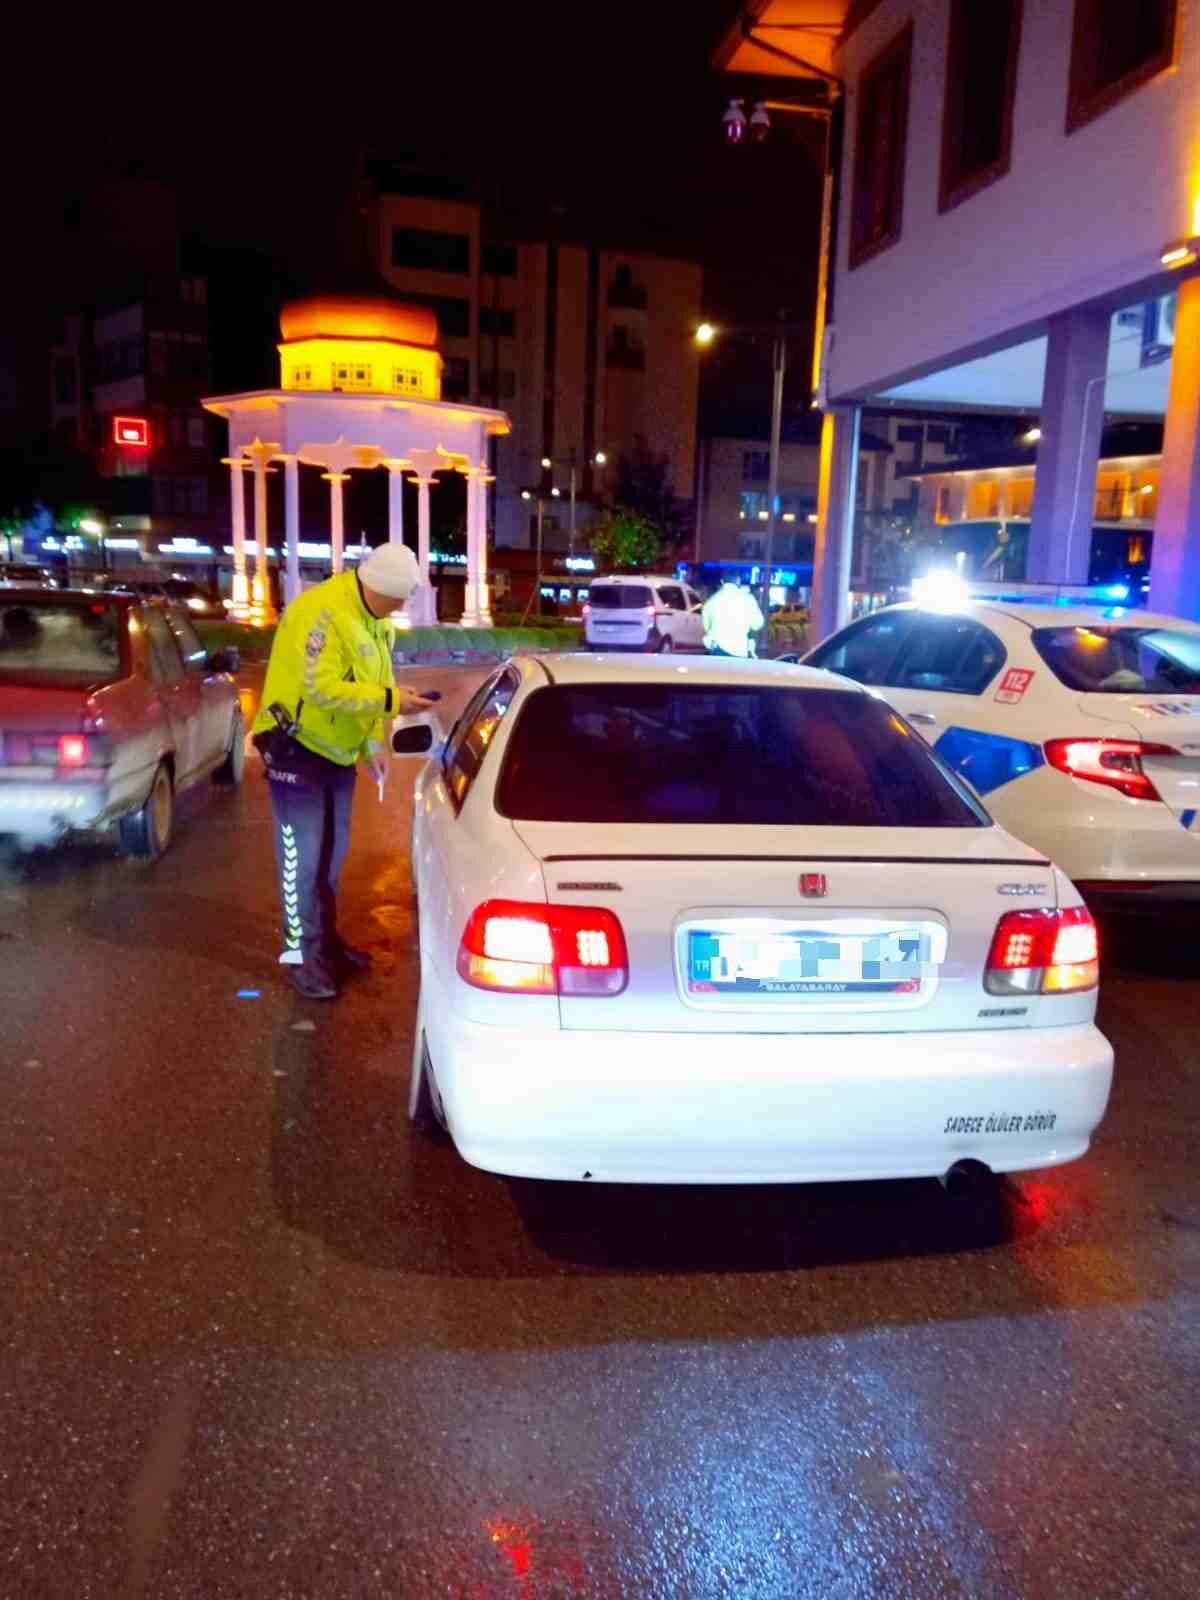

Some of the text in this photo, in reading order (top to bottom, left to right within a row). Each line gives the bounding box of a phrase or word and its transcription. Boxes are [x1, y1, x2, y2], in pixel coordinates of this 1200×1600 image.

[1003, 671, 1029, 690] 112
[695, 959, 710, 972] TR
[943, 1115, 984, 1134] SADECE
[985, 1111, 1023, 1134] ÖLÜLER
